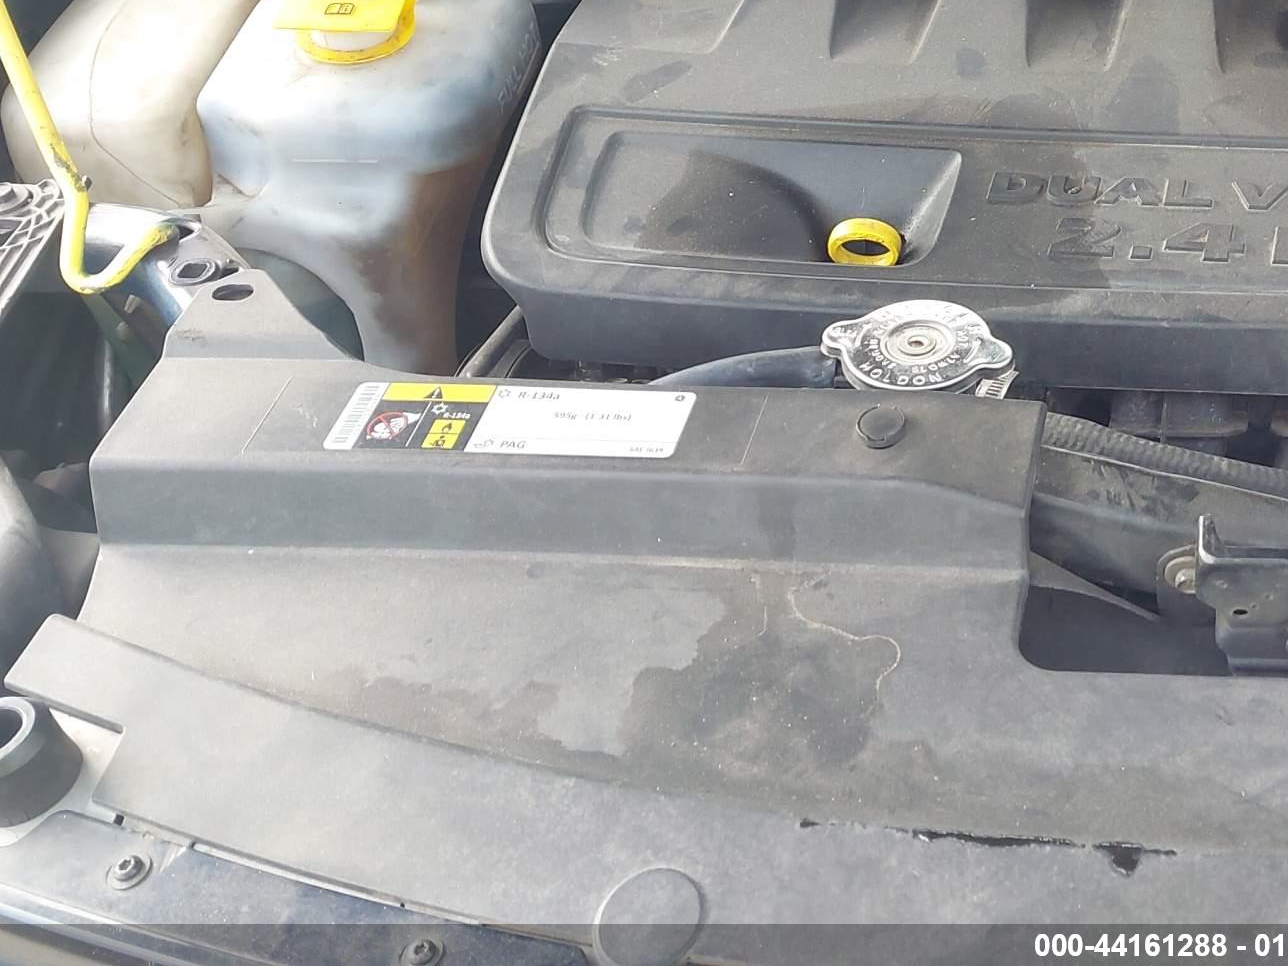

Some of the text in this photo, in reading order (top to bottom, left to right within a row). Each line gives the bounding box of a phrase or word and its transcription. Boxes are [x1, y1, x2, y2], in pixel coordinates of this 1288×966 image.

[986, 170, 1215, 210] DUAL
[518, 391, 561, 401] R-134a
[500, 440, 527, 449] PAG
